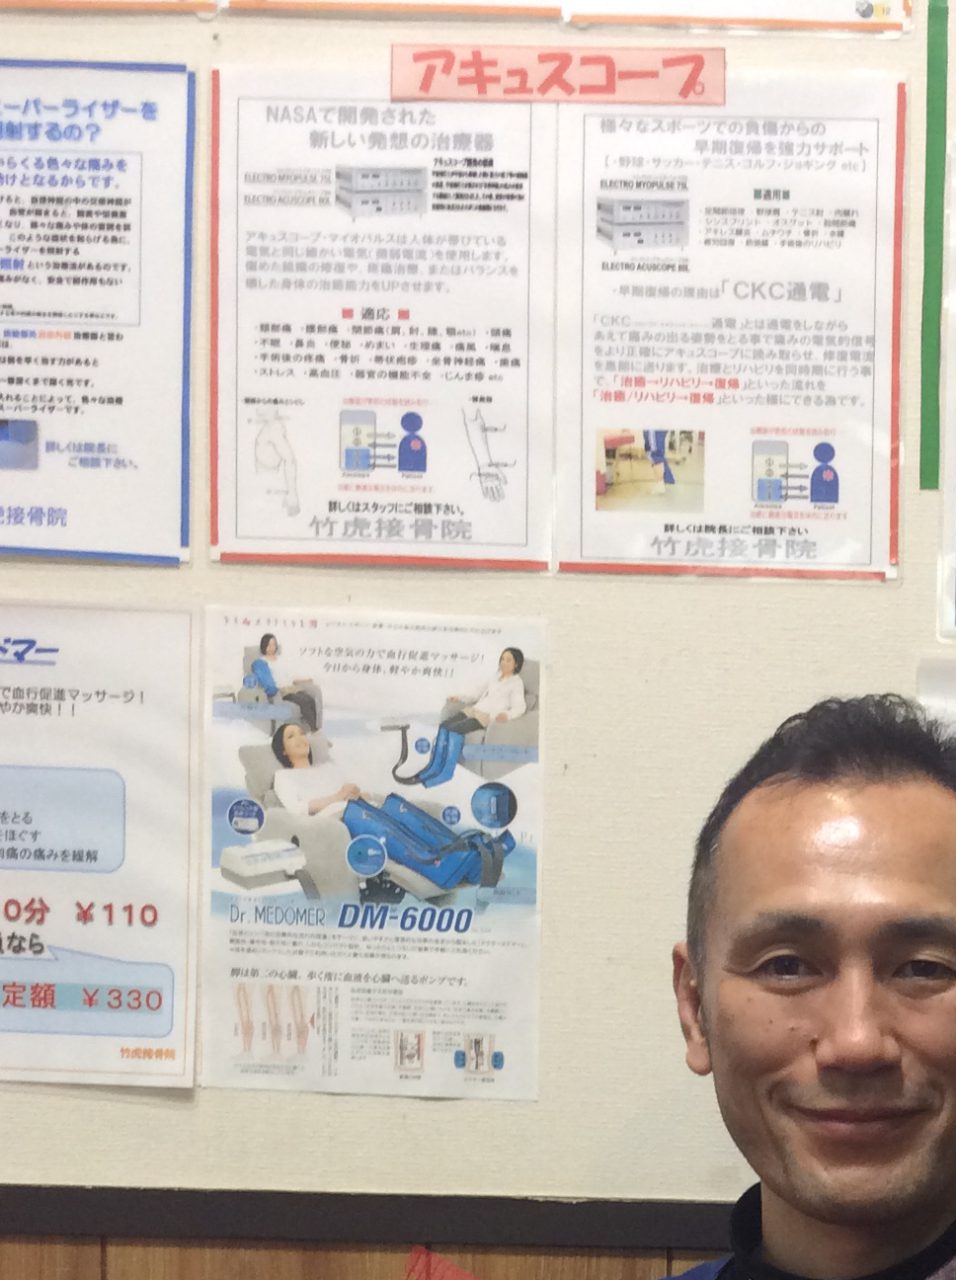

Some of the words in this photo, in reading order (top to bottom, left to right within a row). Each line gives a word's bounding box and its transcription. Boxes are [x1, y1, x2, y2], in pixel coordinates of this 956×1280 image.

[412, 50, 706, 99] アキュスコープ
[266, 104, 436, 126] NASAで開発された
[310, 132, 494, 152] 新しい発想の治療器
[337, 903, 473, 933] DM-6000
[0, 932, 45, 954] なら
[2, 982, 56, 1009] 定額
